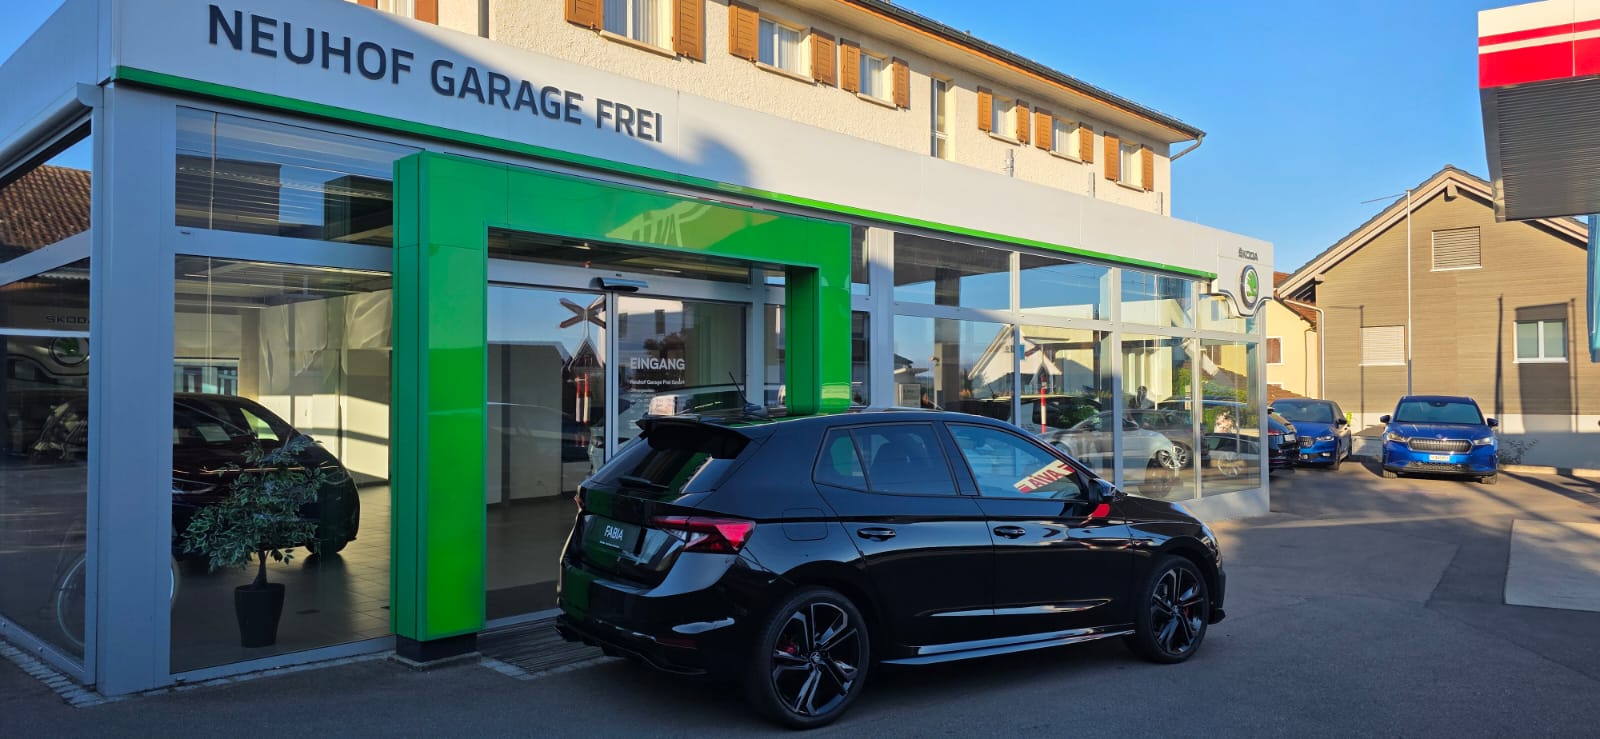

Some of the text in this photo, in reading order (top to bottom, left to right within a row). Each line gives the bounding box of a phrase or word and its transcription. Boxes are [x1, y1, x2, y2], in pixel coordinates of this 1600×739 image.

[208, 4, 663, 143] NEUHOF GARAGE FREI
[630, 357, 685, 370] EINGANG
[604, 525, 624, 541] FABIA
